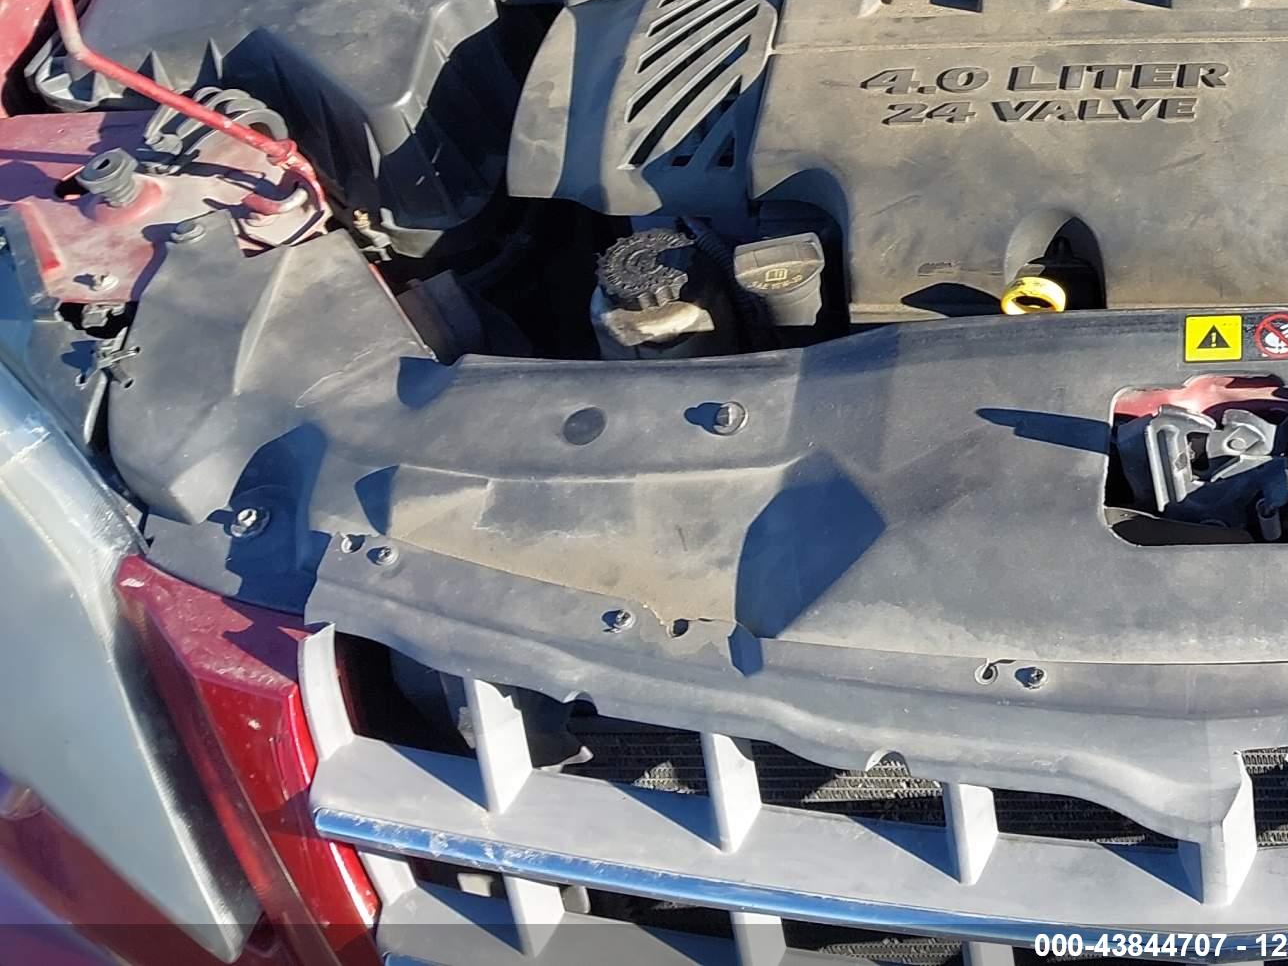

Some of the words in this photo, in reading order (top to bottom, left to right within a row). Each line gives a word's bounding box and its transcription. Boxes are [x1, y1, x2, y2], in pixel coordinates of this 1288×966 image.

[859, 66, 990, 94] 4.0
[1006, 62, 1230, 91] LITER
[881, 101, 977, 126] 24
[991, 97, 1199, 123] VALVE
